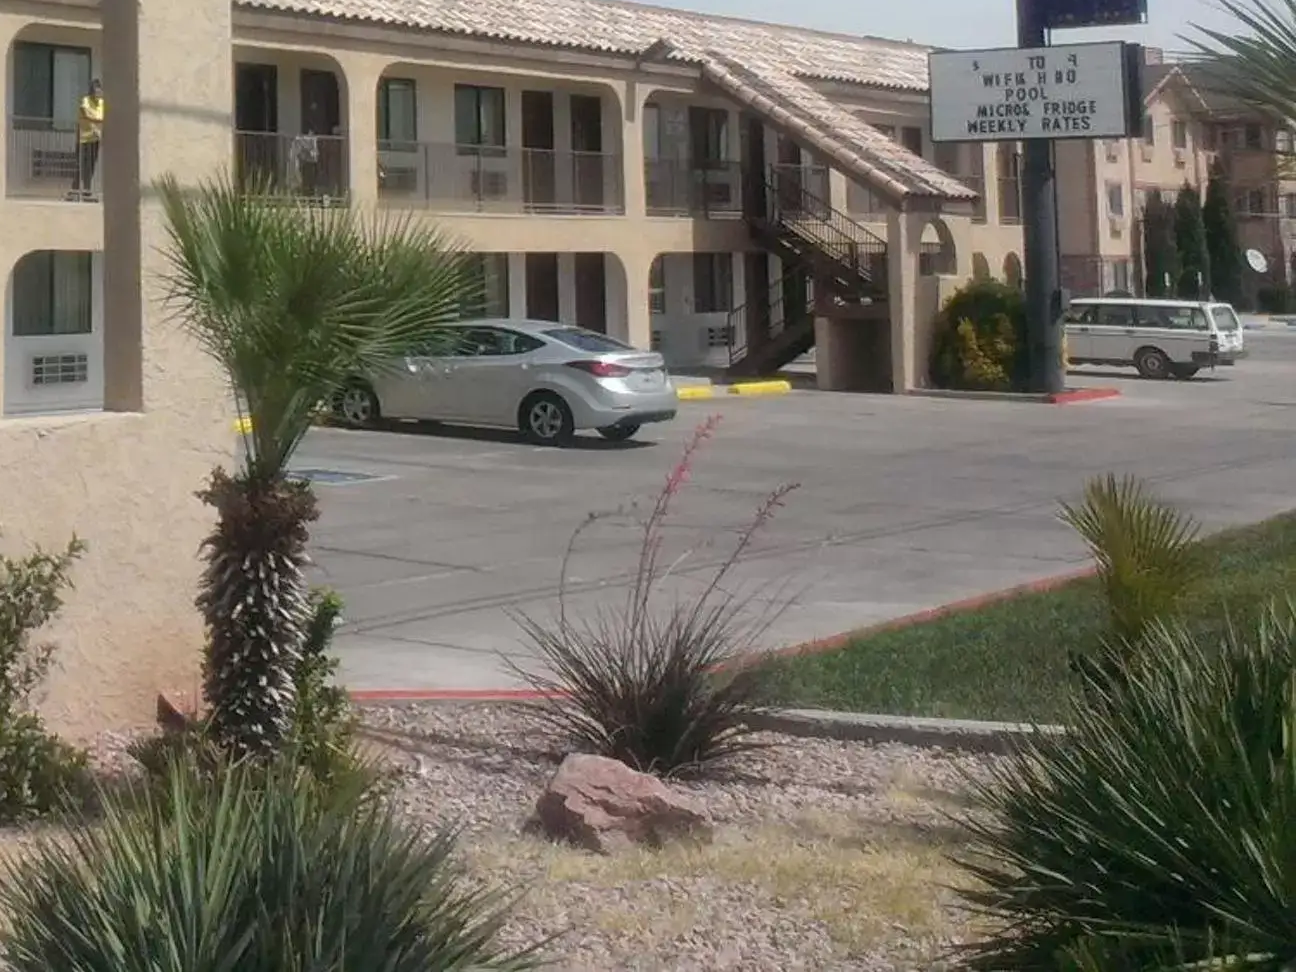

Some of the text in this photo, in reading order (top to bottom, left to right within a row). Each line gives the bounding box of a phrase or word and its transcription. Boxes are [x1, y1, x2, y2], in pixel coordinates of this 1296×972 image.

[1028, 55, 1046, 70] TO
[1004, 87, 1048, 102] POOL
[1042, 100, 1097, 115] FRIDGE
[967, 115, 1092, 134] WEEKLY RATES
